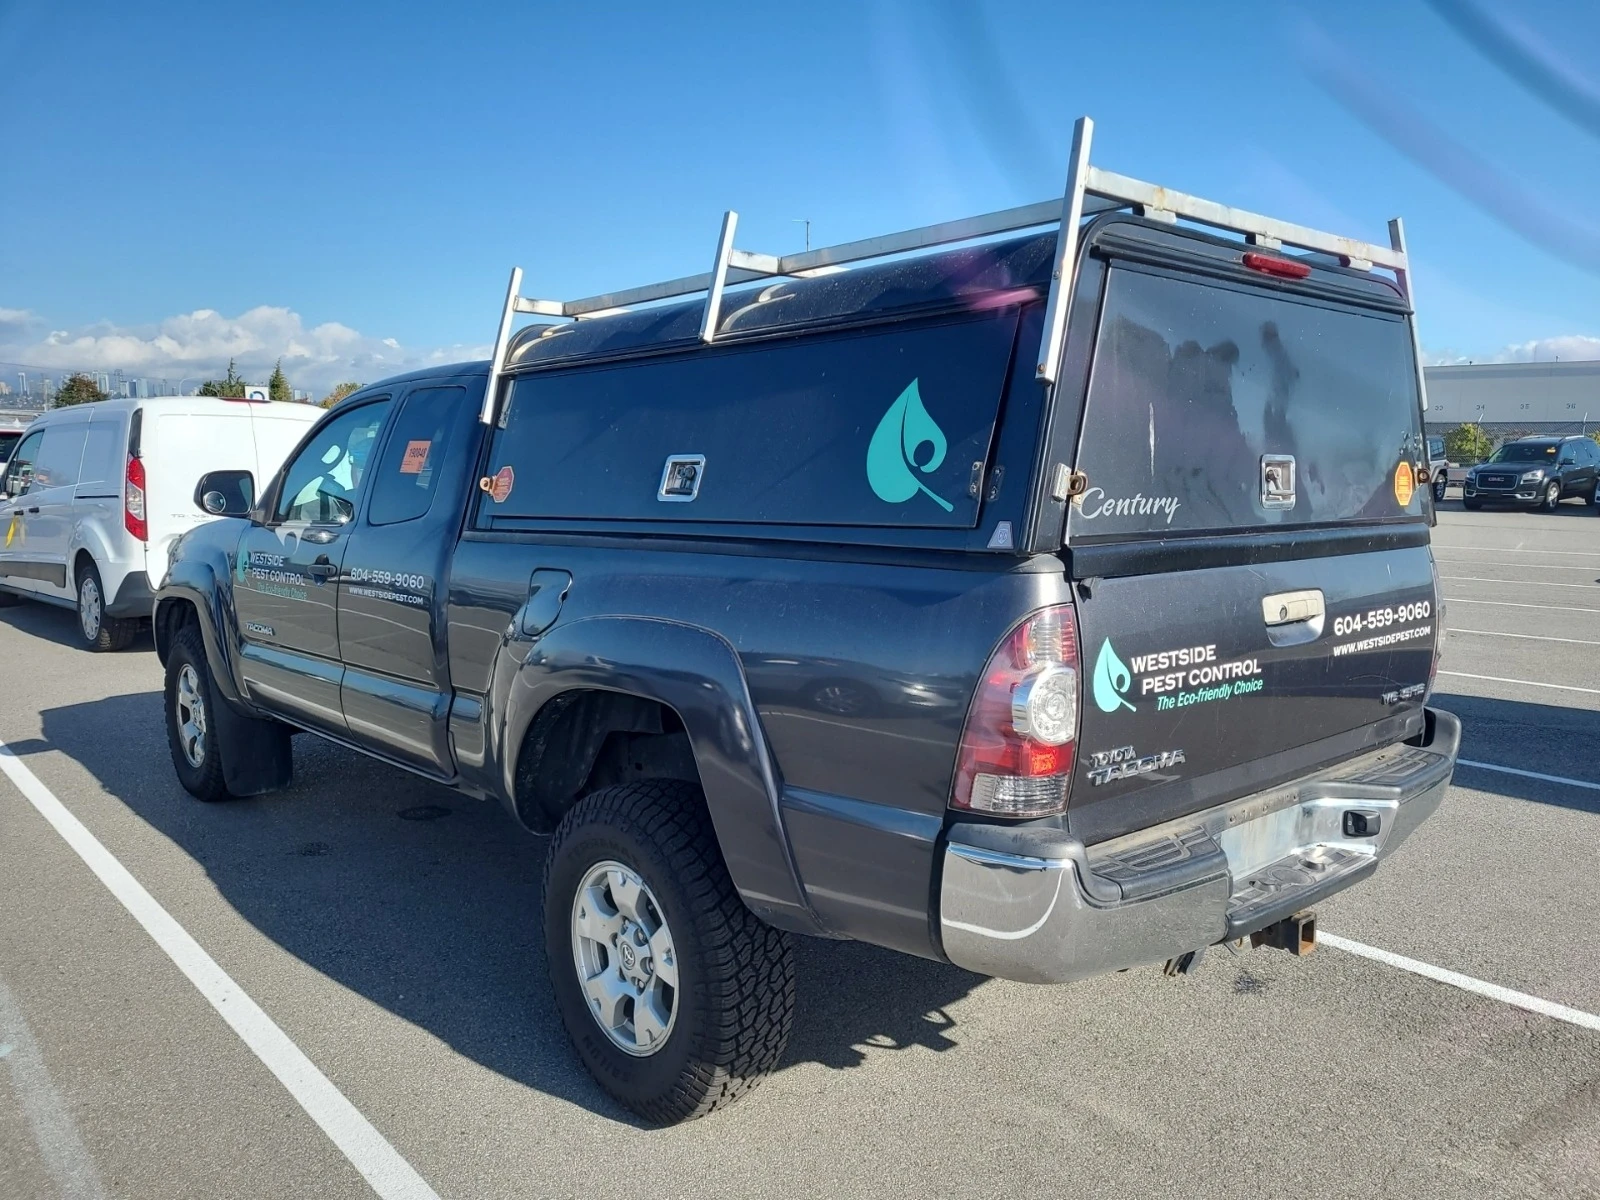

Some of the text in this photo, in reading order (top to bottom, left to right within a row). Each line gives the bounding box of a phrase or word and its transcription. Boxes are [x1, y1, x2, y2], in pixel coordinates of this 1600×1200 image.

[1080, 487, 1181, 524] Century
[250, 552, 284, 567] WESTSIDE
[251, 567, 306, 587] PEST CONTROL
[350, 567, 425, 590] 604-559-9060
[349, 586, 424, 605] WWW.WESTSIDEPEST.COM
[246, 622, 274, 636] TACOMA
[1333, 600, 1431, 636] 604-559-9060
[1333, 625, 1431, 657] WWW.WESTSIDEPEST.COM
[1131, 644, 1216, 674] WESTSIDE
[1141, 658, 1262, 695] PEST CONTROL
[1157, 678, 1263, 711] The Eco-friendly Choice
[1086, 749, 1186, 786] TACOMA
[1090, 745, 1136, 768] TOYOTA
